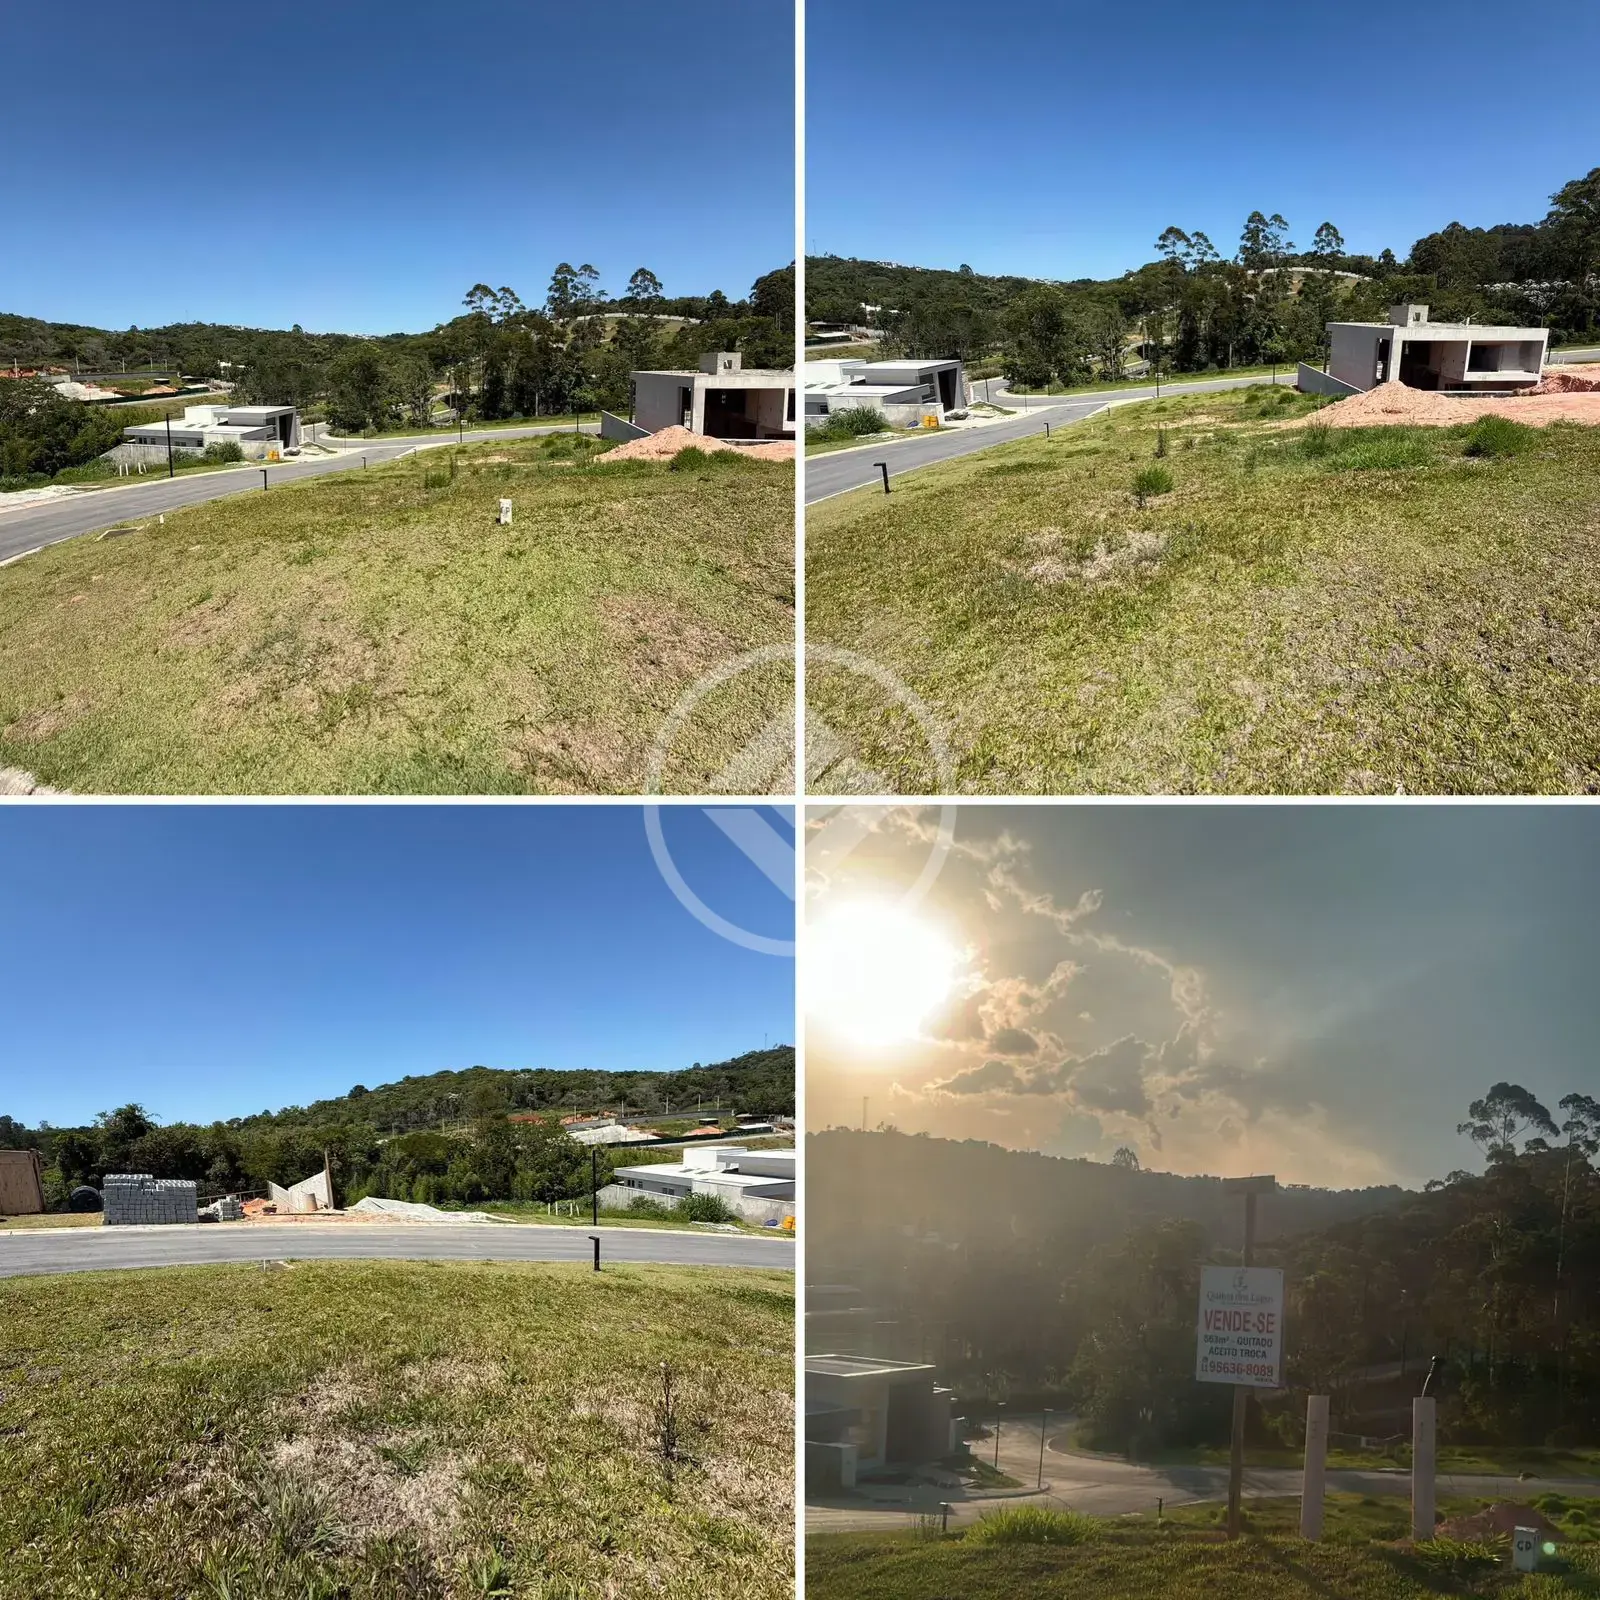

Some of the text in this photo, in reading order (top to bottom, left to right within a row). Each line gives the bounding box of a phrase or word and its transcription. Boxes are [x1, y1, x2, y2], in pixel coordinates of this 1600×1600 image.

[1205, 1309, 1276, 1334] VENDE-SE
[1237, 1336, 1273, 1348] QUITADO
[1208, 1346, 1267, 1359] ACEITO TROCA
[1517, 1540, 1532, 1552] CD
